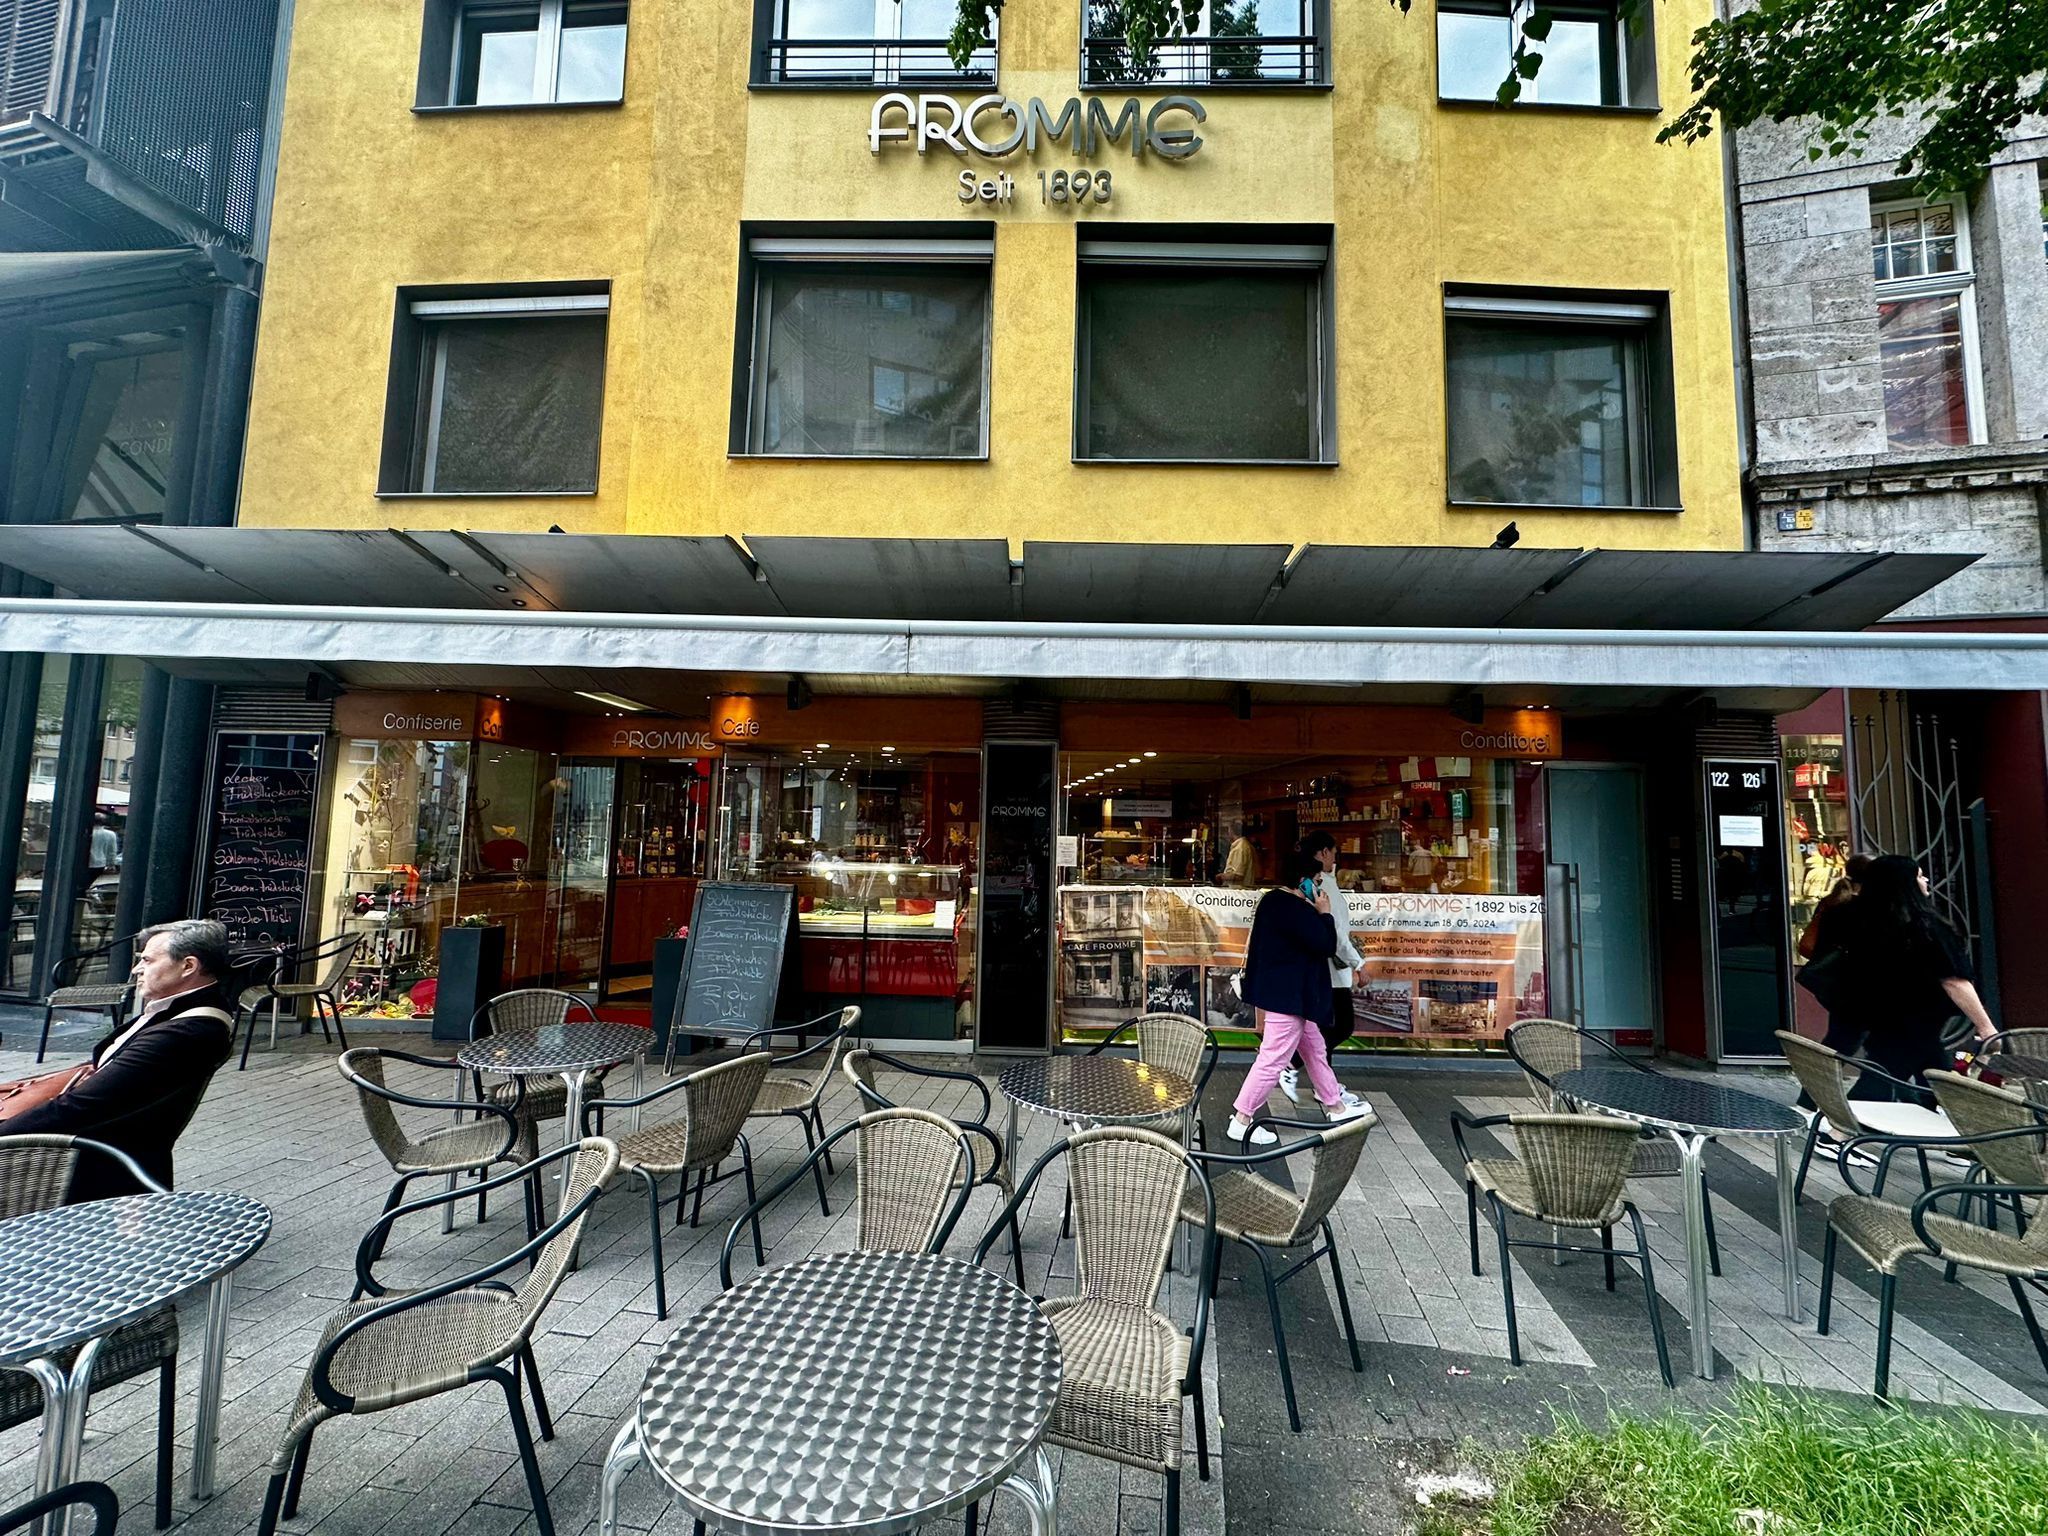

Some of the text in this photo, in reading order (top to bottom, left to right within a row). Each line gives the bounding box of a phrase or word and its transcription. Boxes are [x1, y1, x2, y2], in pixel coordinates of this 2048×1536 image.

[958, 169, 1112, 204] Seit 1893
[383, 712, 462, 731] Confiserie
[721, 717, 760, 737] Cafe
[1460, 731, 1552, 753] Conditorei
[1711, 772, 1730, 787] 122
[1742, 773, 1760, 788] 126
[1348, 900, 1371, 911] erie
[1474, 902, 1504, 913] 1892
[1509, 902, 1526, 914] bis
[1349, 918, 1364, 927] das
[1388, 918, 1421, 927] Fromme
[1092, 940, 1136, 950] FROMME
[1400, 936, 1430, 944] Inventar
[1364, 946, 1386, 954] schaft
[1402, 946, 1413, 954] das
[1382, 966, 1406, 975] Familie
[1436, 968, 1450, 976] und
[1452, 968, 1494, 977] Mitarbeiter
